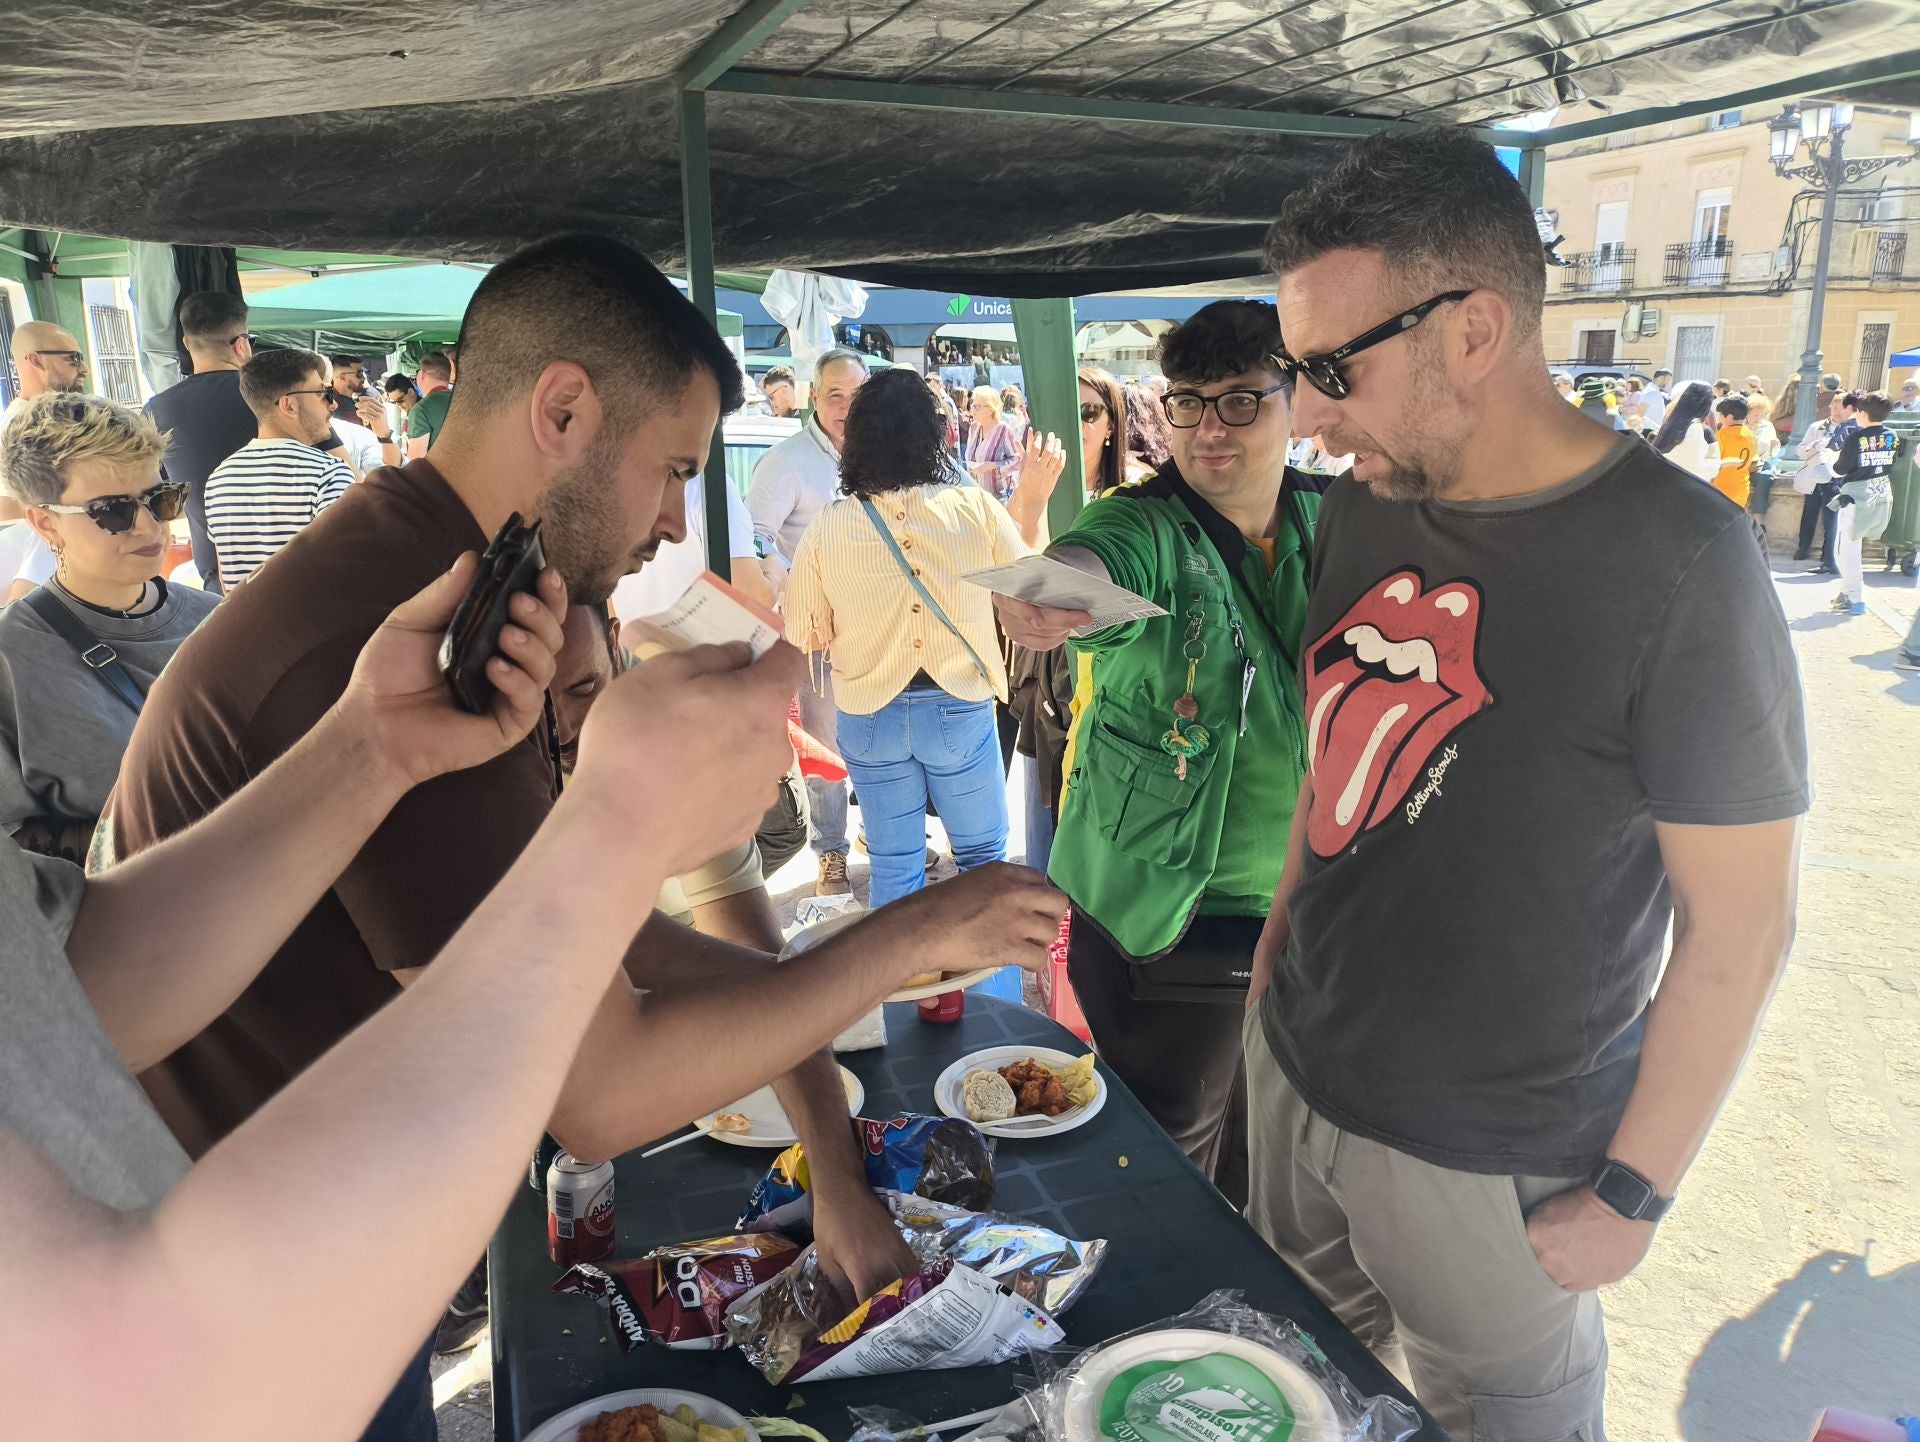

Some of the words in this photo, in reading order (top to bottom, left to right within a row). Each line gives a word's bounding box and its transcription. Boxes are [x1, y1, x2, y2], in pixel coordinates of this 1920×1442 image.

[973, 301, 1012, 316] Unica
[1406, 782, 1442, 825] Rolling
[1428, 743, 1459, 786] Stones
[734, 1265, 745, 1283] RIB
[742, 1258, 756, 1290] SSION
[611, 1294, 646, 1342] AHORA
[1158, 1372, 1185, 1393] 10
[1168, 1408, 1185, 1423] 100%
[1183, 1417, 1221, 1442] RECICLABLE
